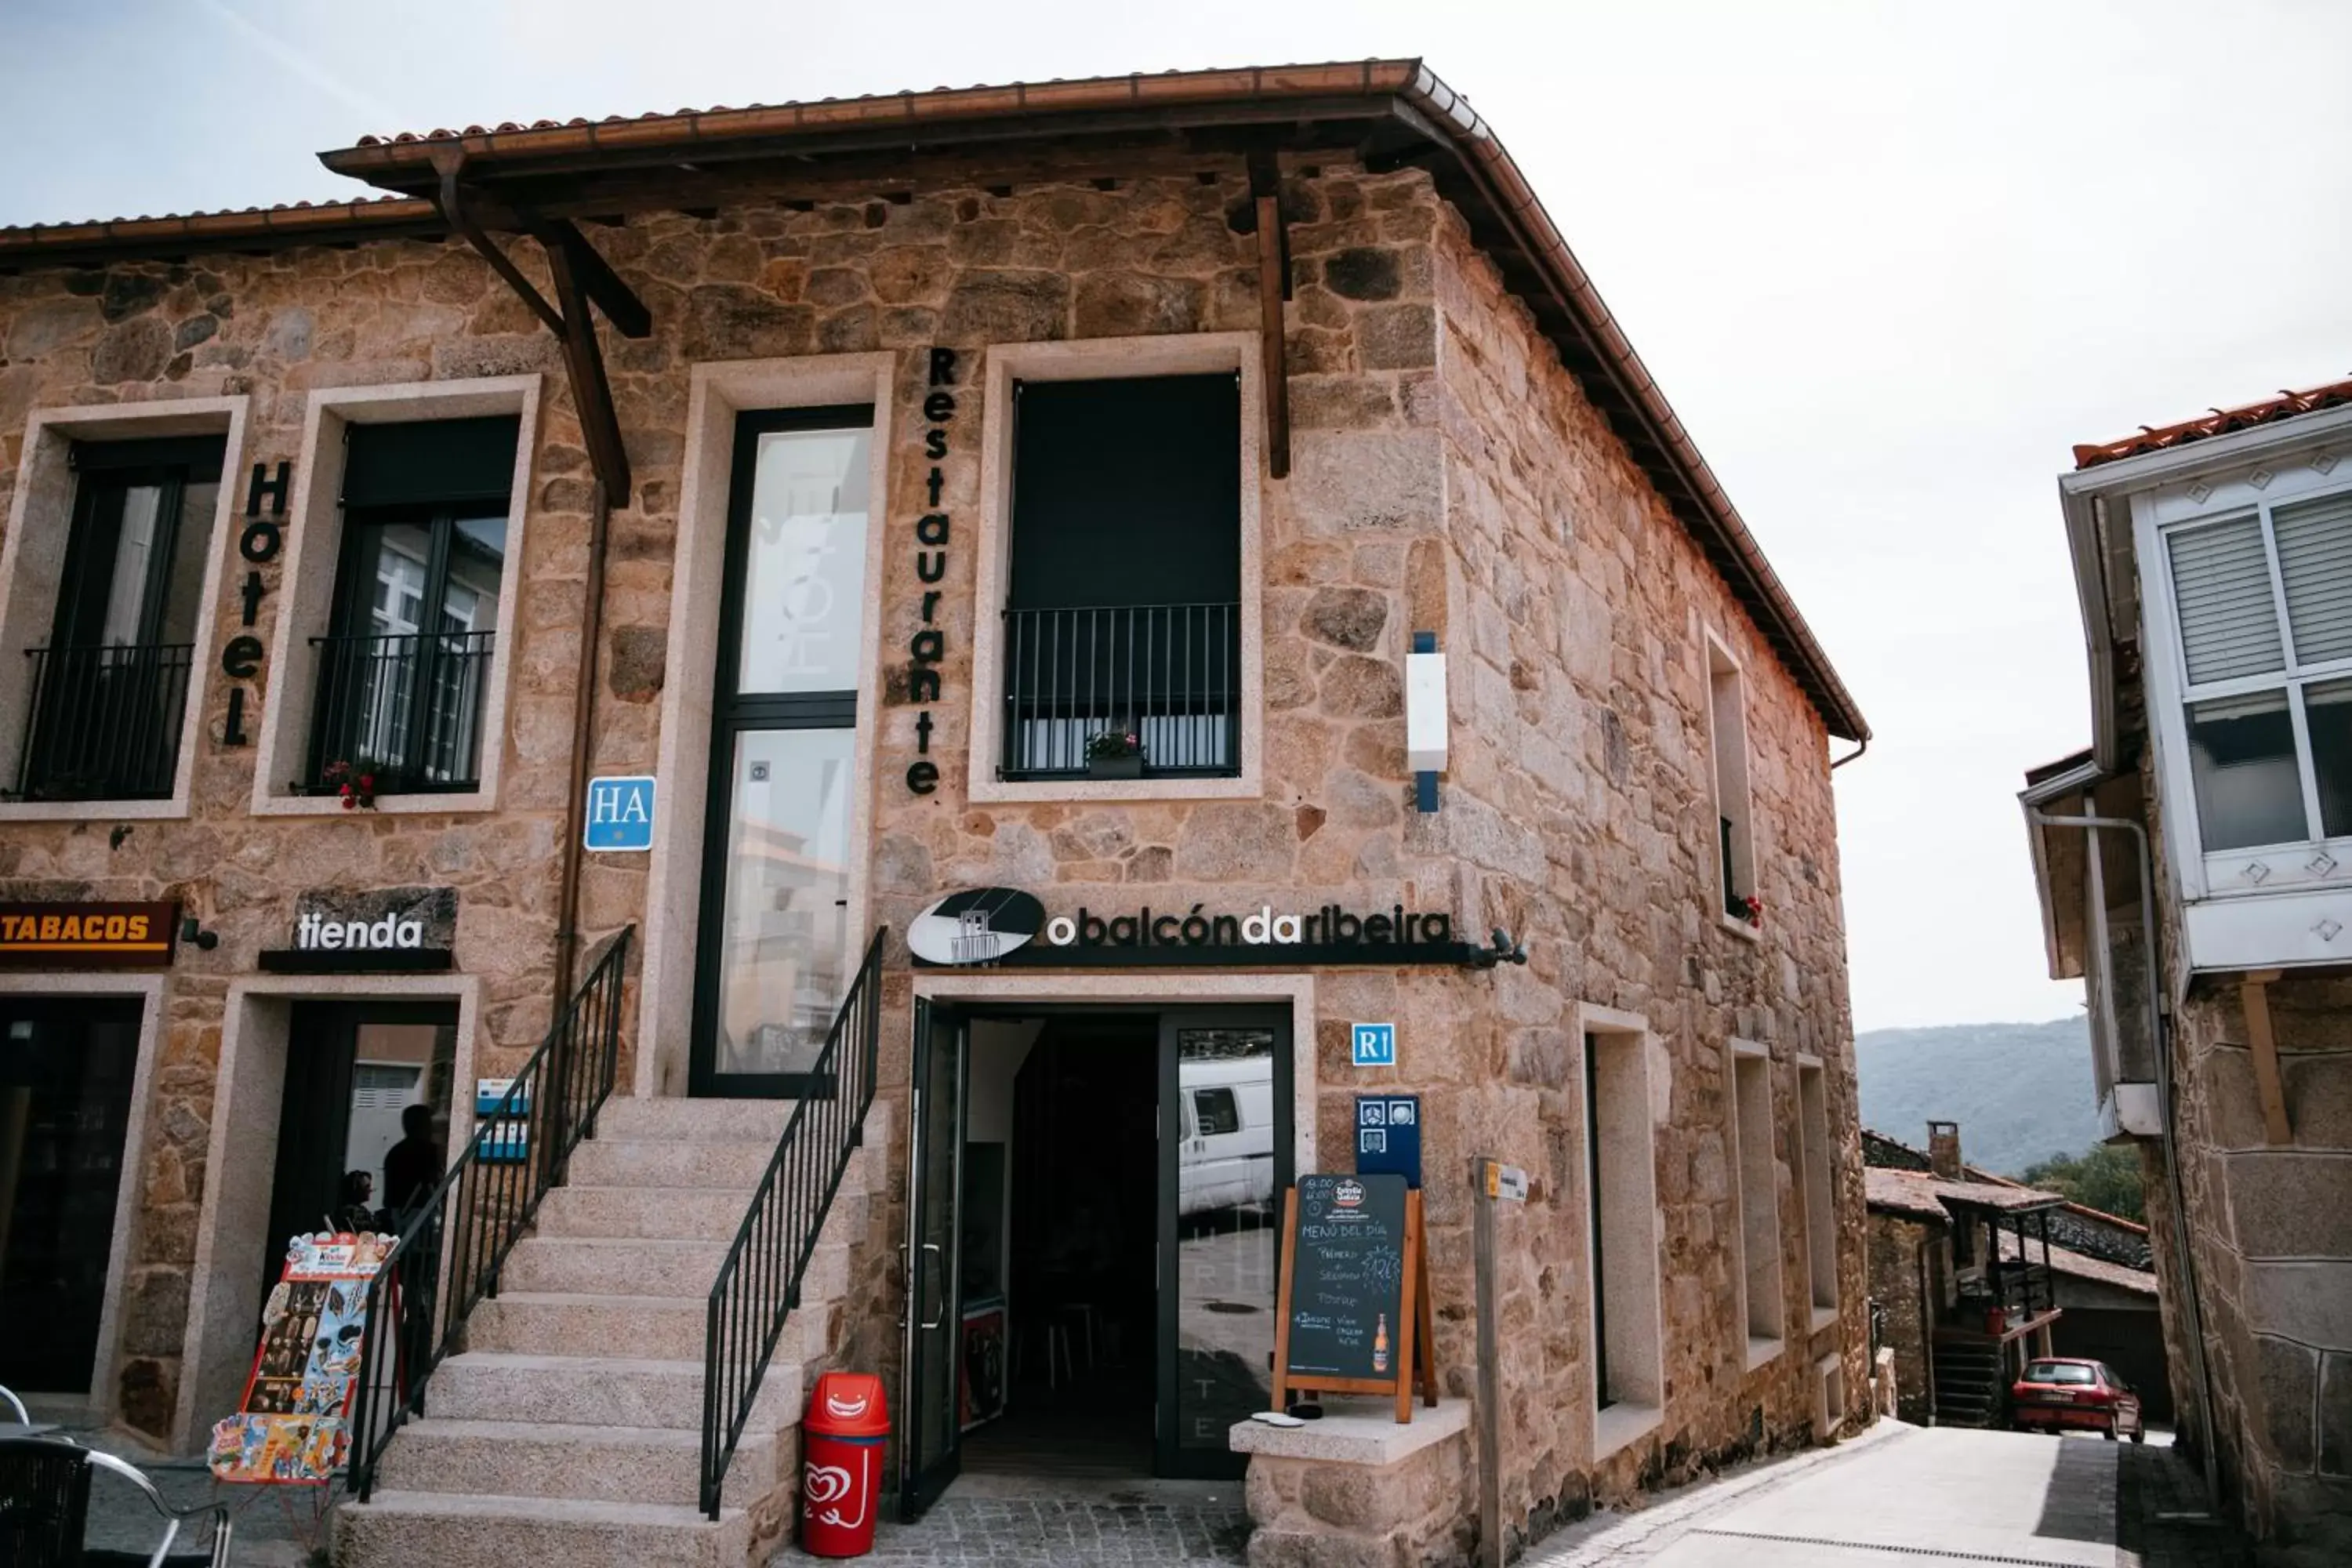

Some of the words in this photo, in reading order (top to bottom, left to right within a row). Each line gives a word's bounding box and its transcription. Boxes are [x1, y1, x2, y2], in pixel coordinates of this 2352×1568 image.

[905, 347, 956, 794] Restaurante
[222, 460, 291, 746] Hotel
[592, 787, 648, 822] HA
[1, 914, 150, 942] TABACOS
[299, 912, 423, 950] tienda
[1359, 1031, 1378, 1058] R
